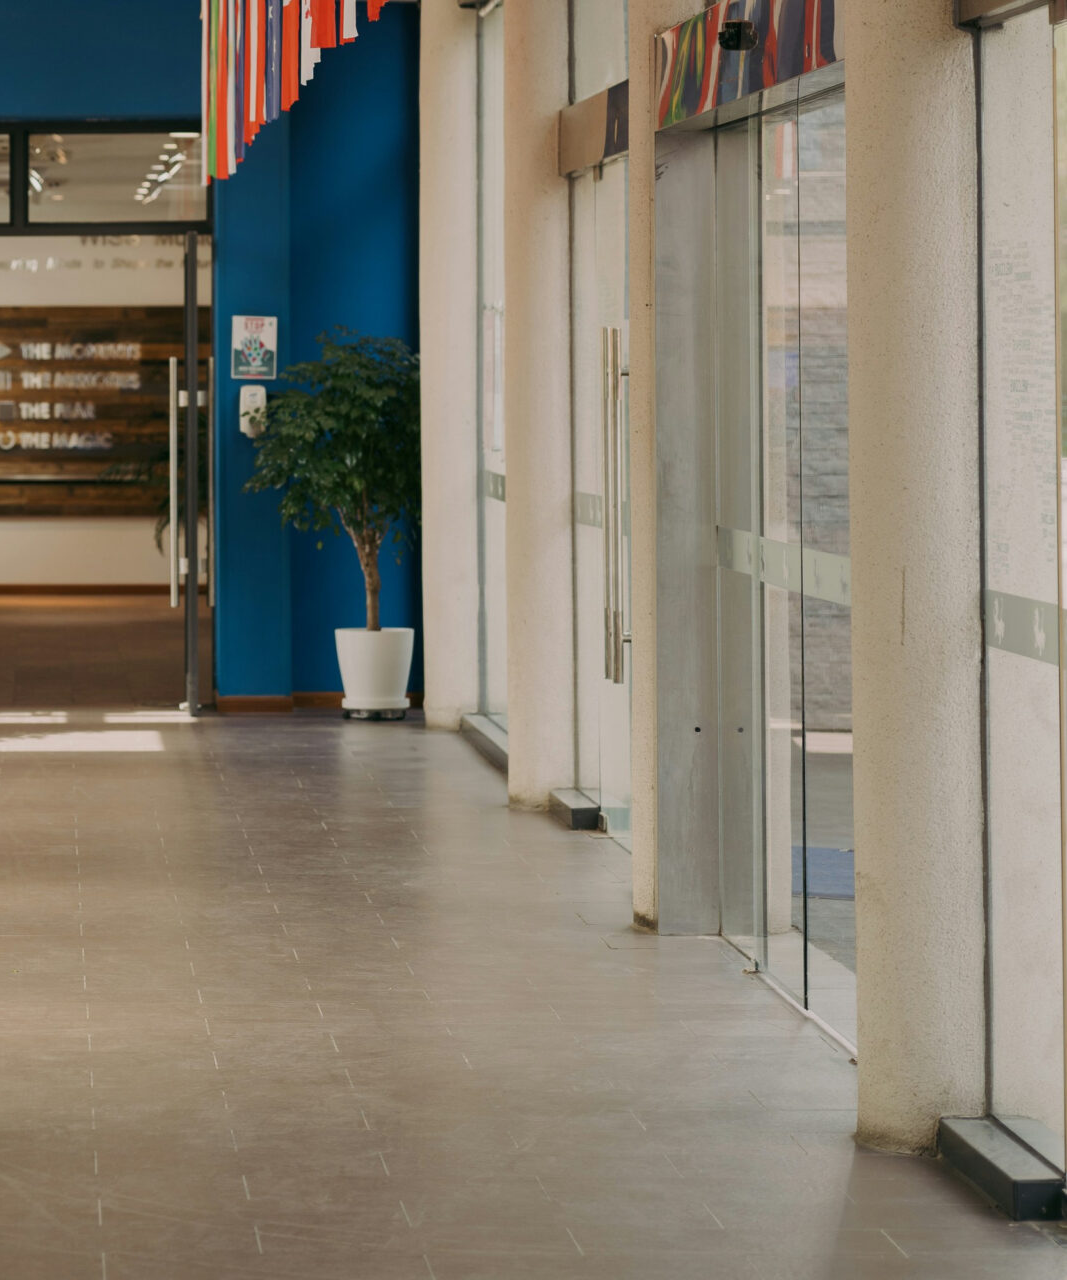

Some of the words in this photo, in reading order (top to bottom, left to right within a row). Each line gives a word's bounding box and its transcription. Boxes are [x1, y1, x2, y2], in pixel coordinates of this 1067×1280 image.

[21, 342, 52, 360] THE
[21, 371, 52, 390] THE
[19, 401, 51, 420] THE
[20, 431, 51, 450] THE
